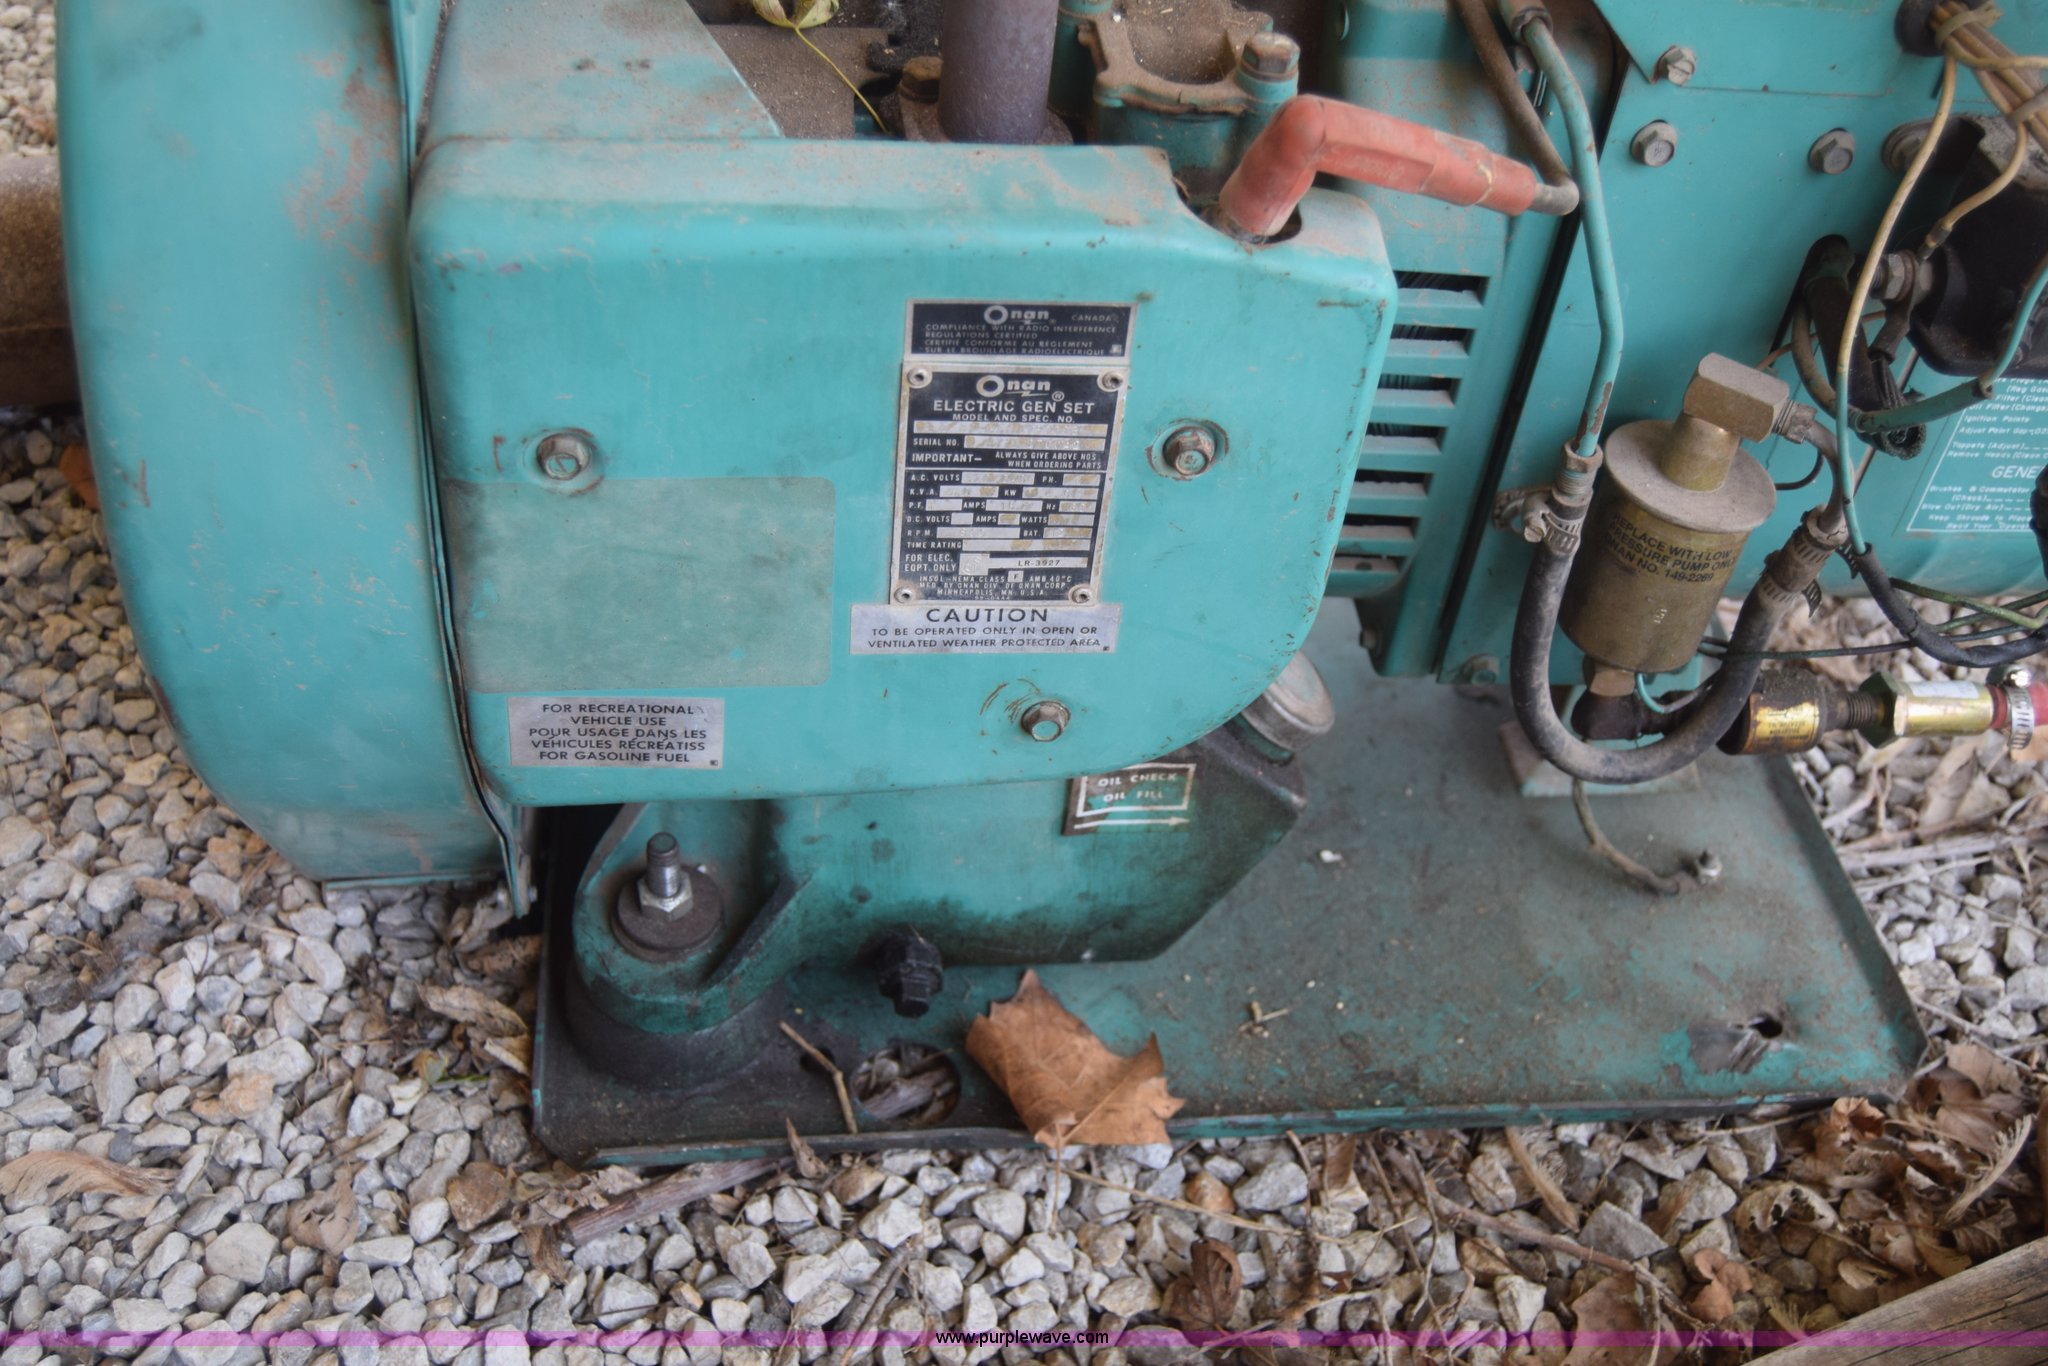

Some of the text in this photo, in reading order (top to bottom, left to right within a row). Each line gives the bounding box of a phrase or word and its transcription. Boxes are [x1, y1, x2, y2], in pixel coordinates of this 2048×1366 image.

[983, 305, 1049, 325] Onan
[1072, 314, 1111, 322] CANADA
[925, 331, 990, 339] REGULATIONS
[976, 375, 1051, 397] Onan
[933, 400, 1095, 414] ELECTRIC GEN SET
[913, 438, 941, 446] SERIAL
[995, 451, 1027, 459] ALWAYS
[1030, 452, 1048, 460] GIVE
[1008, 460, 1030, 468] WHEN
[1033, 461, 1073, 469] ORDERING
[1991, 465, 2041, 478] GENE
[1669, 545, 1703, 560] WITH
[905, 554, 953, 562] FOR ELEC.
[933, 564, 957, 572] ONLY
[1637, 558, 1659, 574] NO.
[1672, 560, 1710, 571] PUMP
[926, 609, 1048, 622] CAUTION
[915, 627, 977, 635] OPERATED
[983, 627, 1016, 635] ONLY
[868, 640, 937, 648] VENTILATED
[943, 639, 996, 647] WEATHER
[1001, 639, 1065, 647] PROTECTED
[543, 704, 694, 714] FOR RECREATIONAL
[571, 716, 667, 726] VEHICLE USE
[529, 728, 707, 738] POUR USAGE DANS LES
[540, 752, 690, 762] FOR GASOLINE FUEL
[1098, 773, 1178, 787] OIL CHECK
[1103, 790, 1163, 802] OIL FILL
